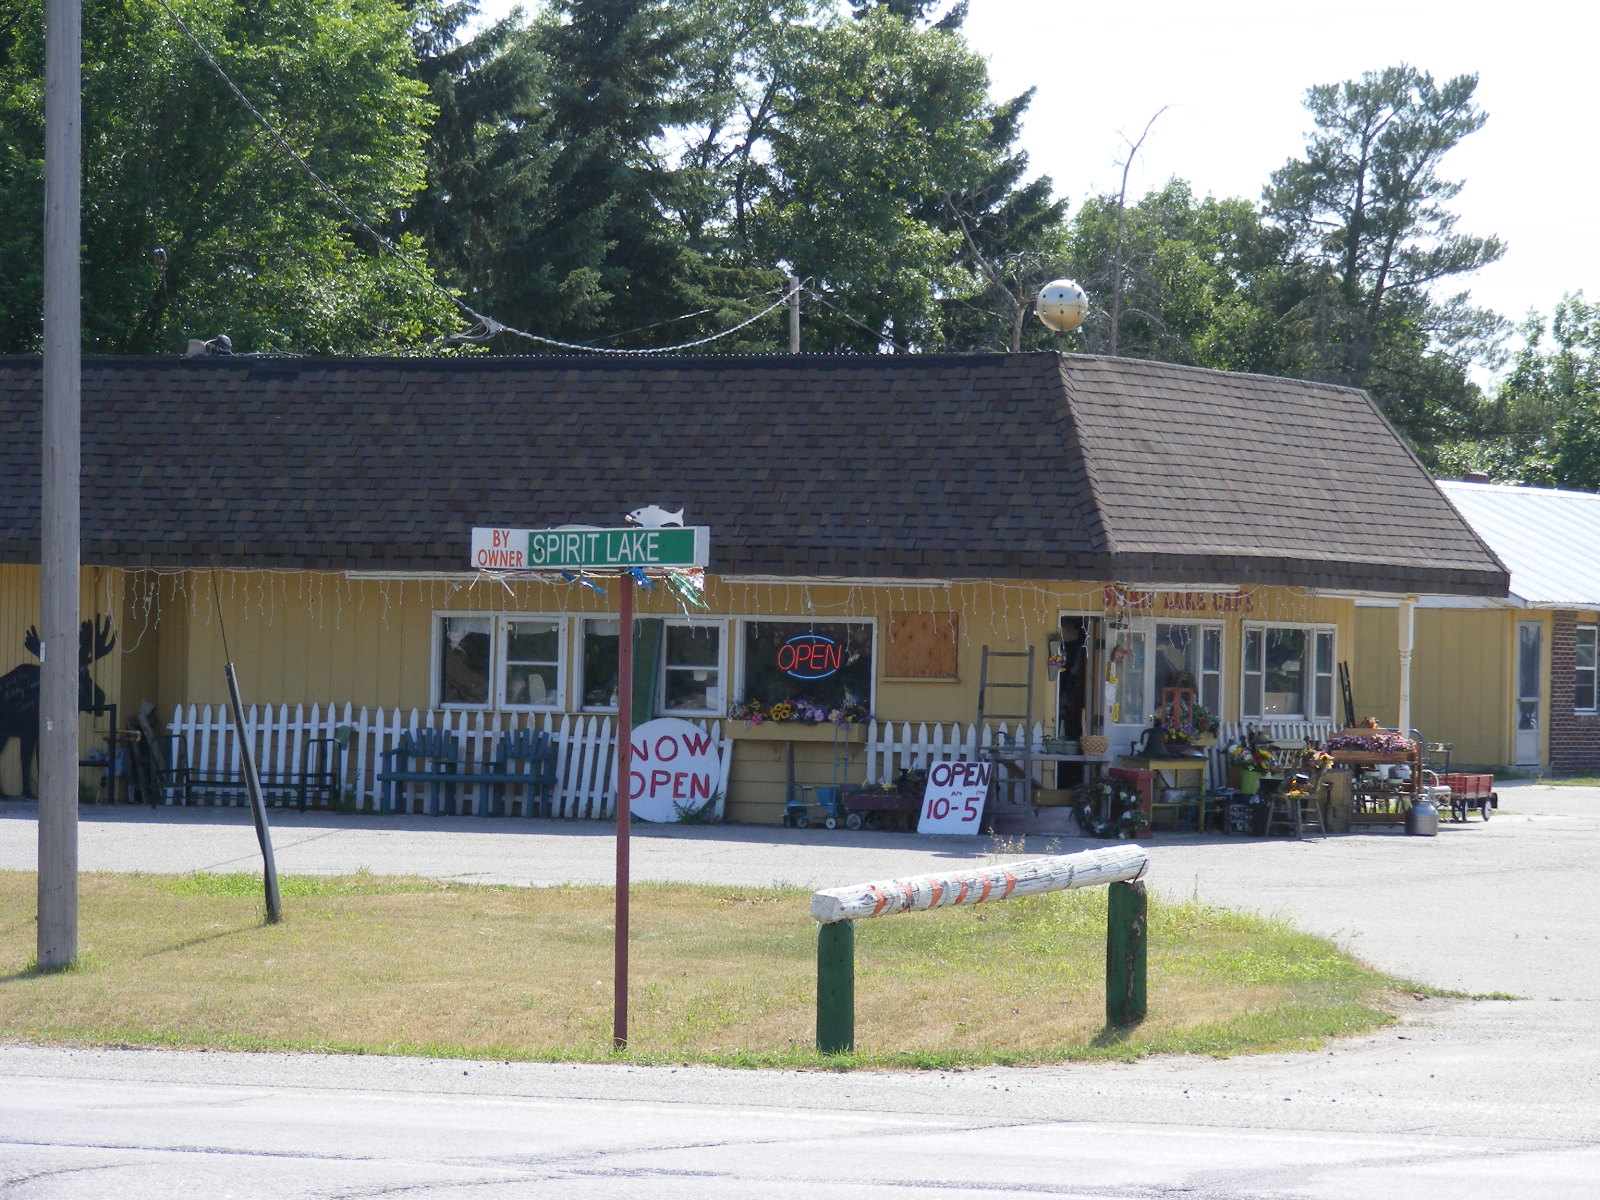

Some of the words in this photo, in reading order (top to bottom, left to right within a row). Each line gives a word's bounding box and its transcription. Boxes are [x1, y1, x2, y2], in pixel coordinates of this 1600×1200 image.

[493, 530, 510, 548] BY
[532, 533, 600, 564] SPIRIT
[606, 532, 660, 562] LAKE
[477, 549, 523, 568] OWNER
[1164, 591, 1206, 611] LAKE
[777, 644, 843, 670] OPEN
[630, 732, 712, 762] NOW
[629, 769, 710, 800] OPEN
[931, 763, 992, 788] OPEN
